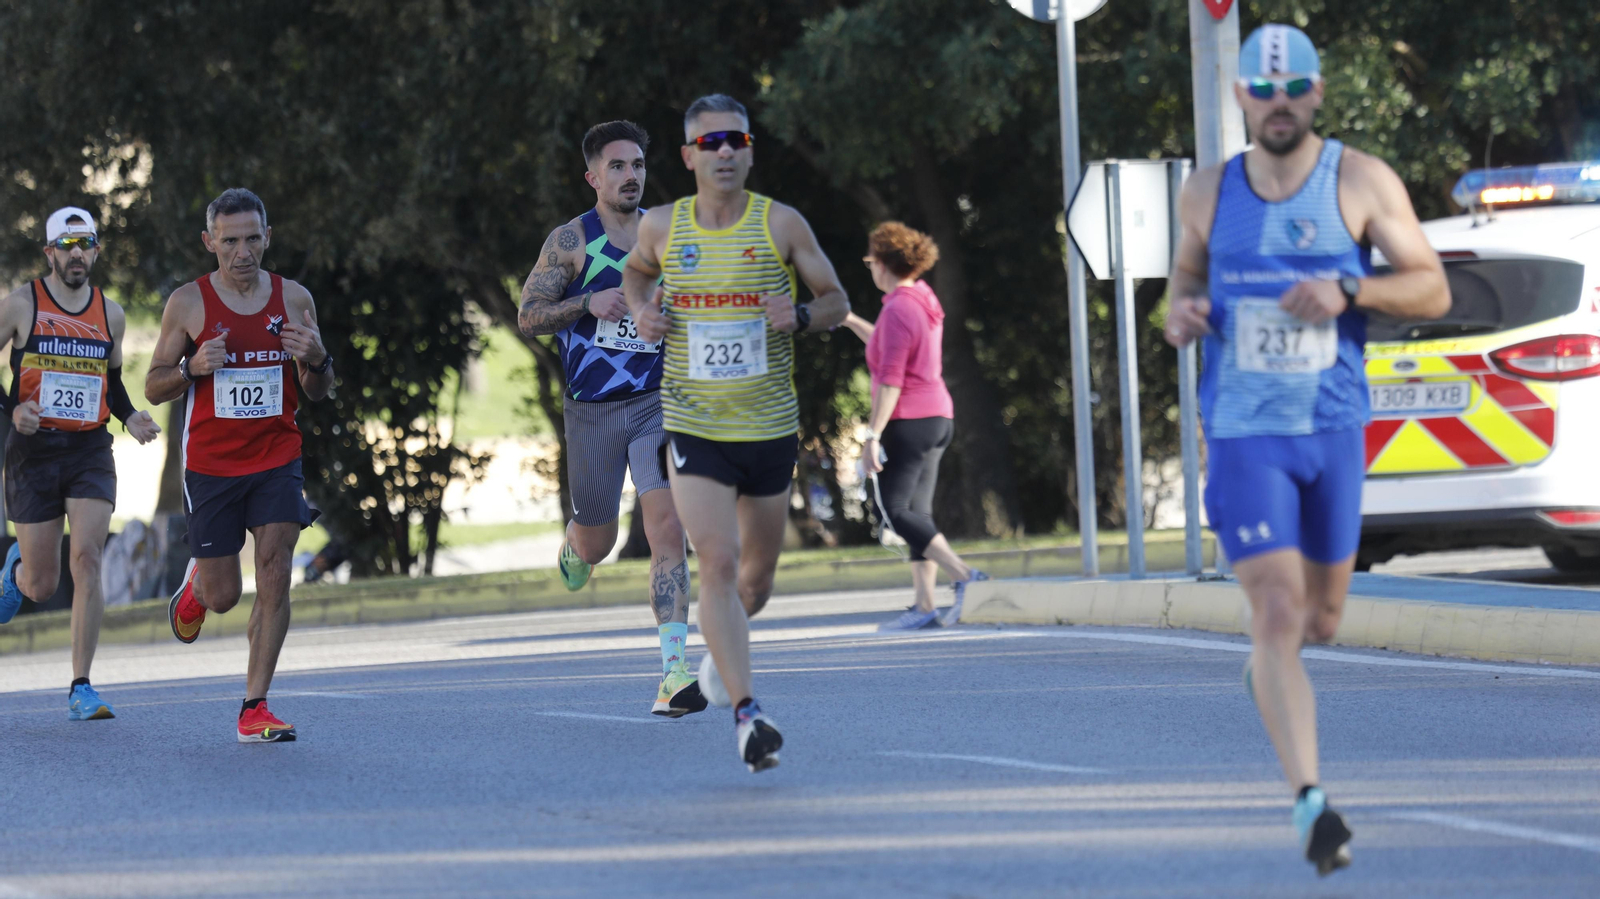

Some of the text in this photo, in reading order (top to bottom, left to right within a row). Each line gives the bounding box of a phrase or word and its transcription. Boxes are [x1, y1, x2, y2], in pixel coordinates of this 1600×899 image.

[673, 292, 768, 308] ESTEPON
[39, 339, 105, 358] atletismo
[614, 342, 645, 350] EVOS
[1257, 327, 1304, 355] 237
[38, 358, 56, 367] LOS
[225, 351, 292, 363] N PEDR
[704, 343, 744, 365] 232
[710, 369, 747, 378] EVOS
[53, 390, 84, 408] 236
[230, 387, 263, 406] 102
[1372, 386, 1463, 406] 1309 KXB
